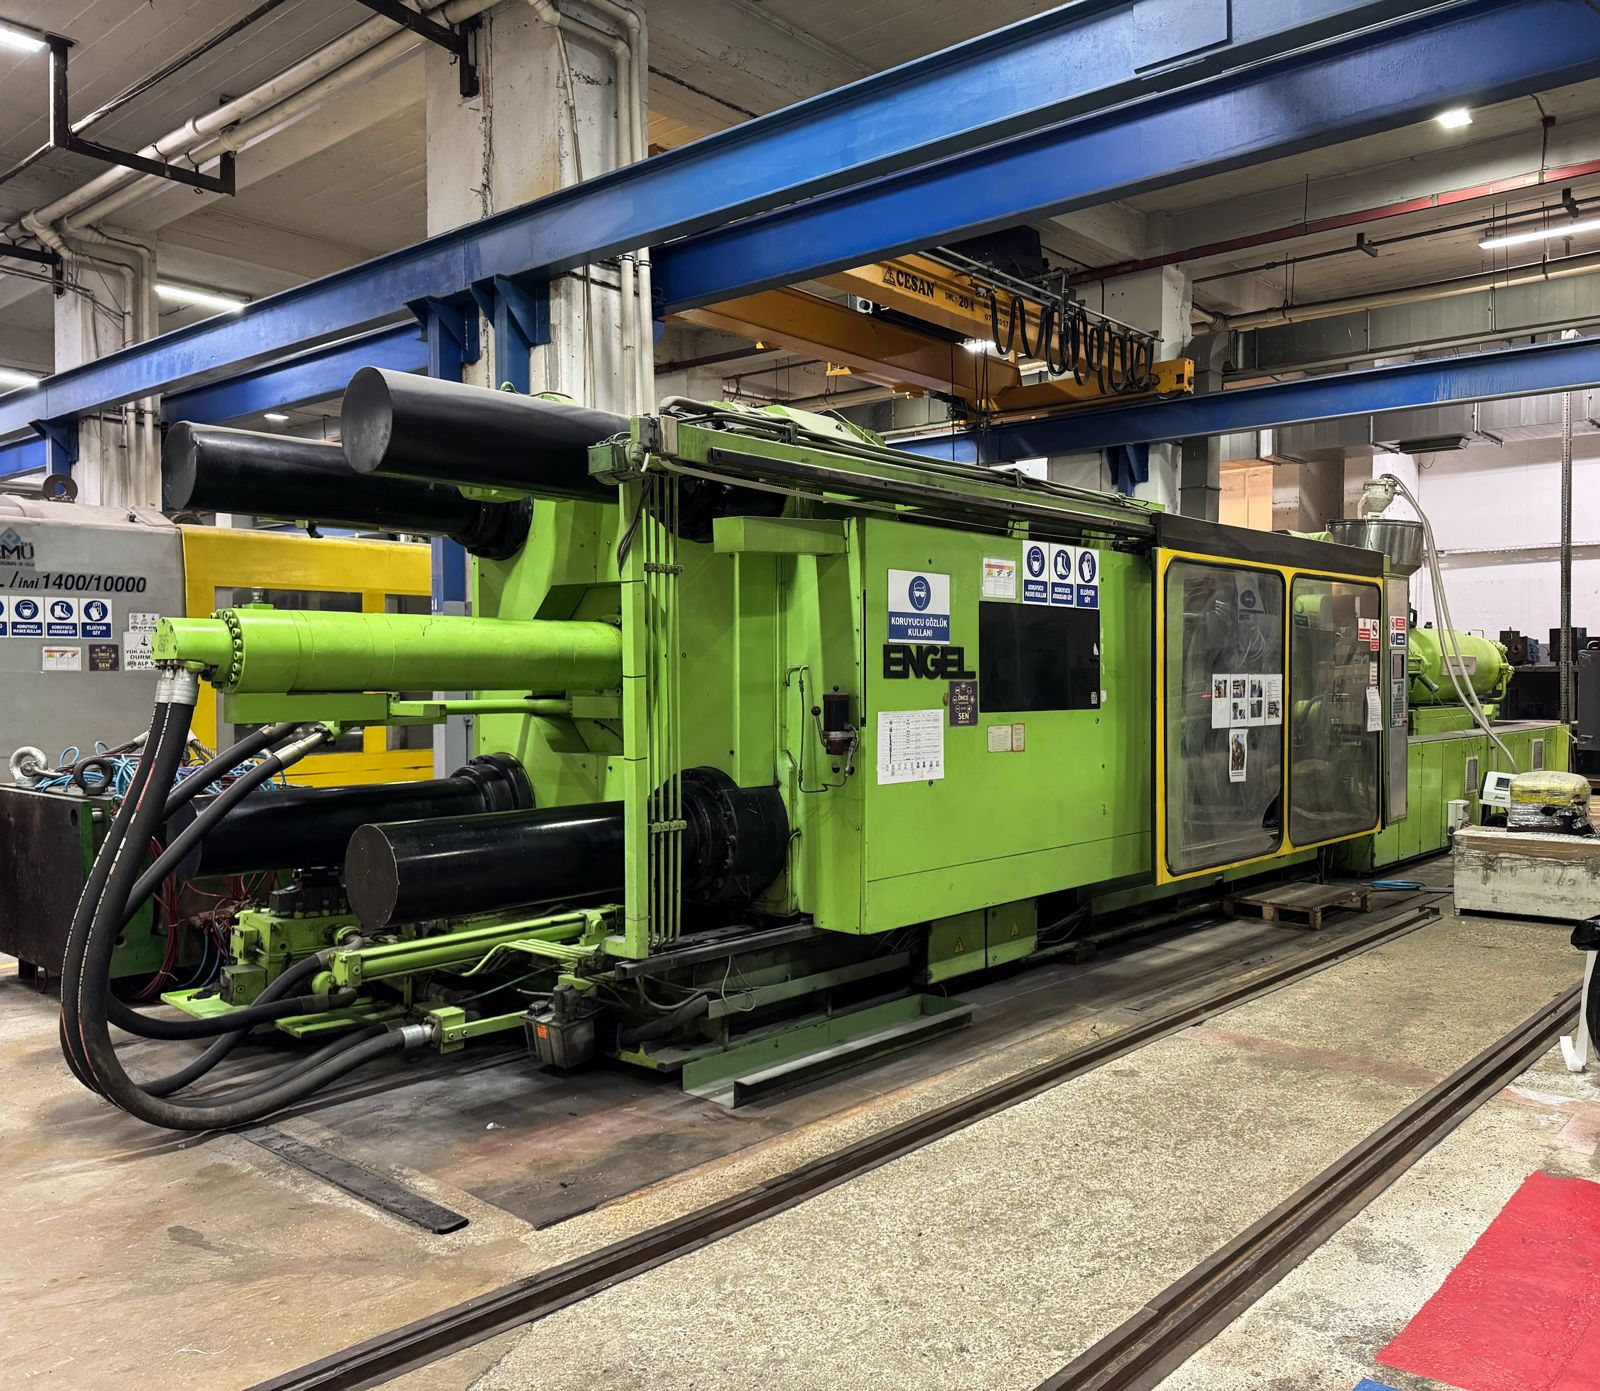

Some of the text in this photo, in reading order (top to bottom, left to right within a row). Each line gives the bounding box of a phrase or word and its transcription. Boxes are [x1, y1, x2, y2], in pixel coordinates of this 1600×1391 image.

[896, 269, 935, 298] CESAN
[958, 295, 969, 310] 20
[0, 542, 35, 560] MÜ
[42, 573, 147, 593] 1400/10000
[891, 617, 948, 628] KORUYUCU GÖZLÜK
[882, 644, 976, 680] ENGEL
[958, 712, 970, 720] SEN
